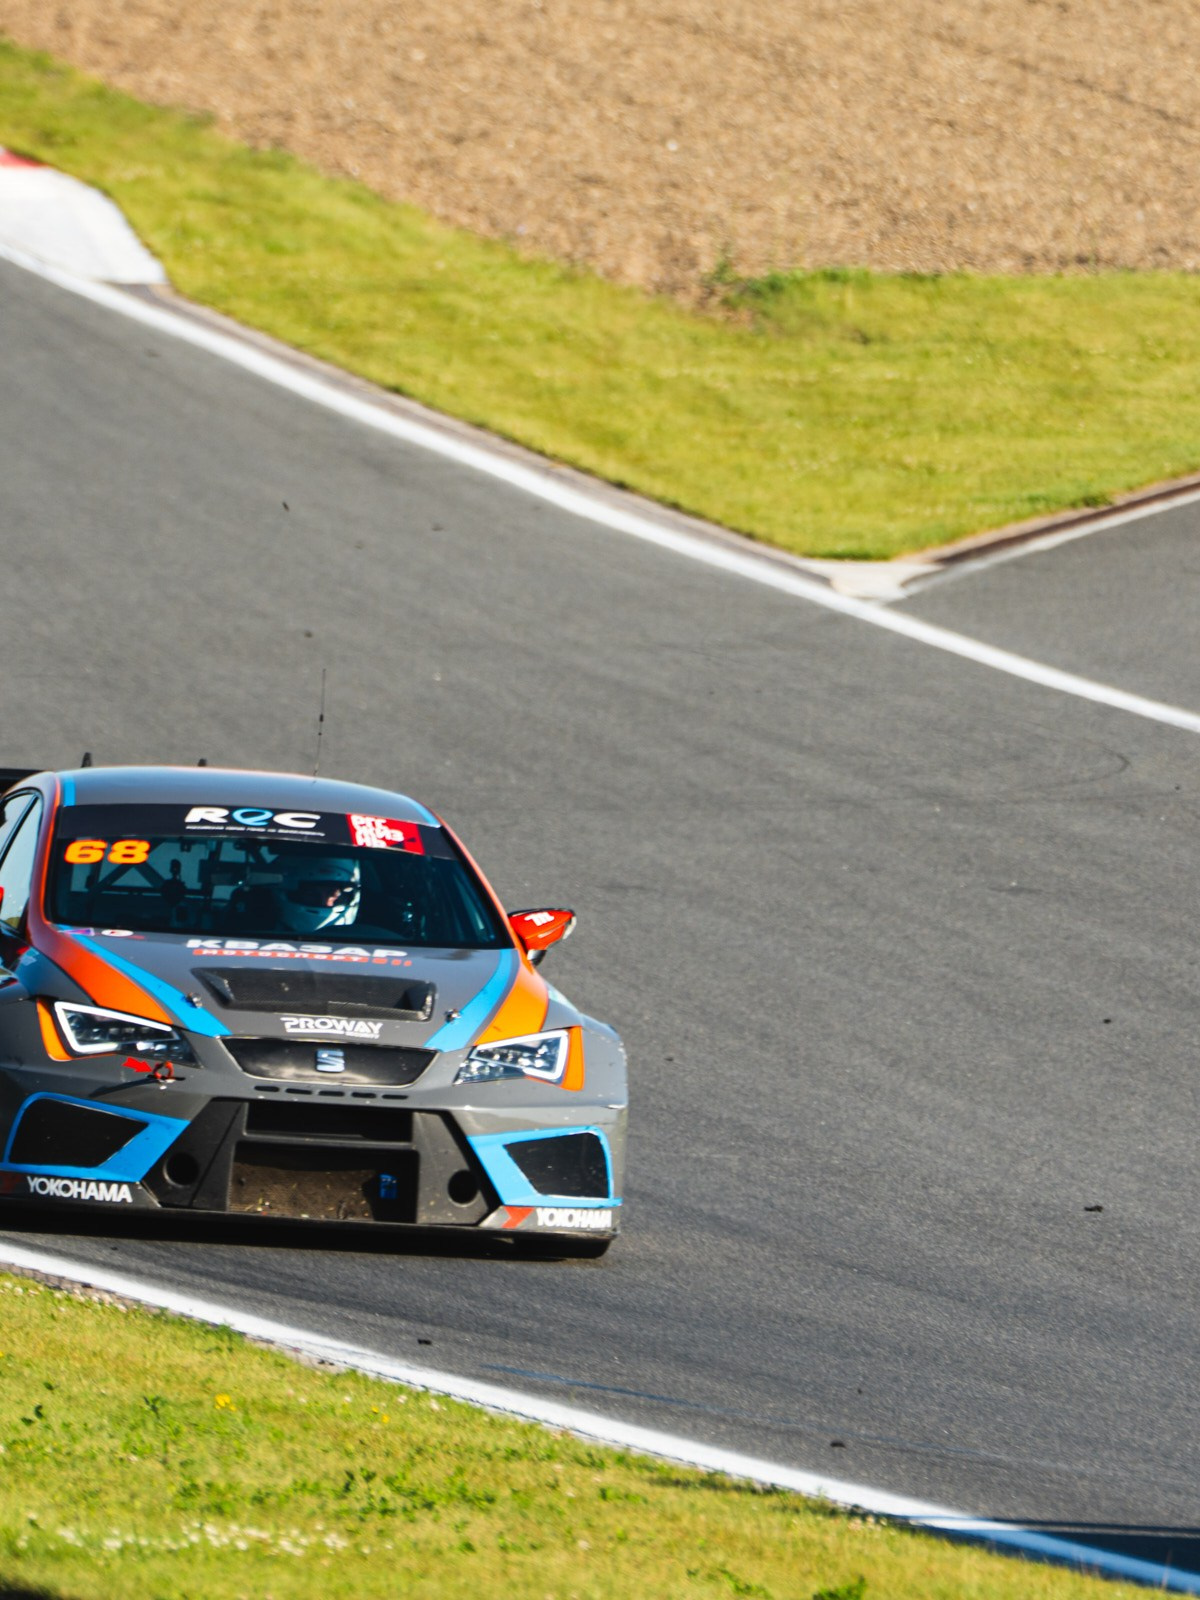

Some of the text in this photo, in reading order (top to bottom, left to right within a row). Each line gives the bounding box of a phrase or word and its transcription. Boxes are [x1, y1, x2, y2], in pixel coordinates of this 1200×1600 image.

[64, 839, 151, 864] 68
[186, 939, 408, 958] КВАЗАР
[202, 948, 362, 962] МОТОСПОРТ
[280, 1017, 384, 1034] PROWAY
[26, 1176, 133, 1203] YOKOHAMA
[536, 1207, 612, 1229] YOKOHAMA
